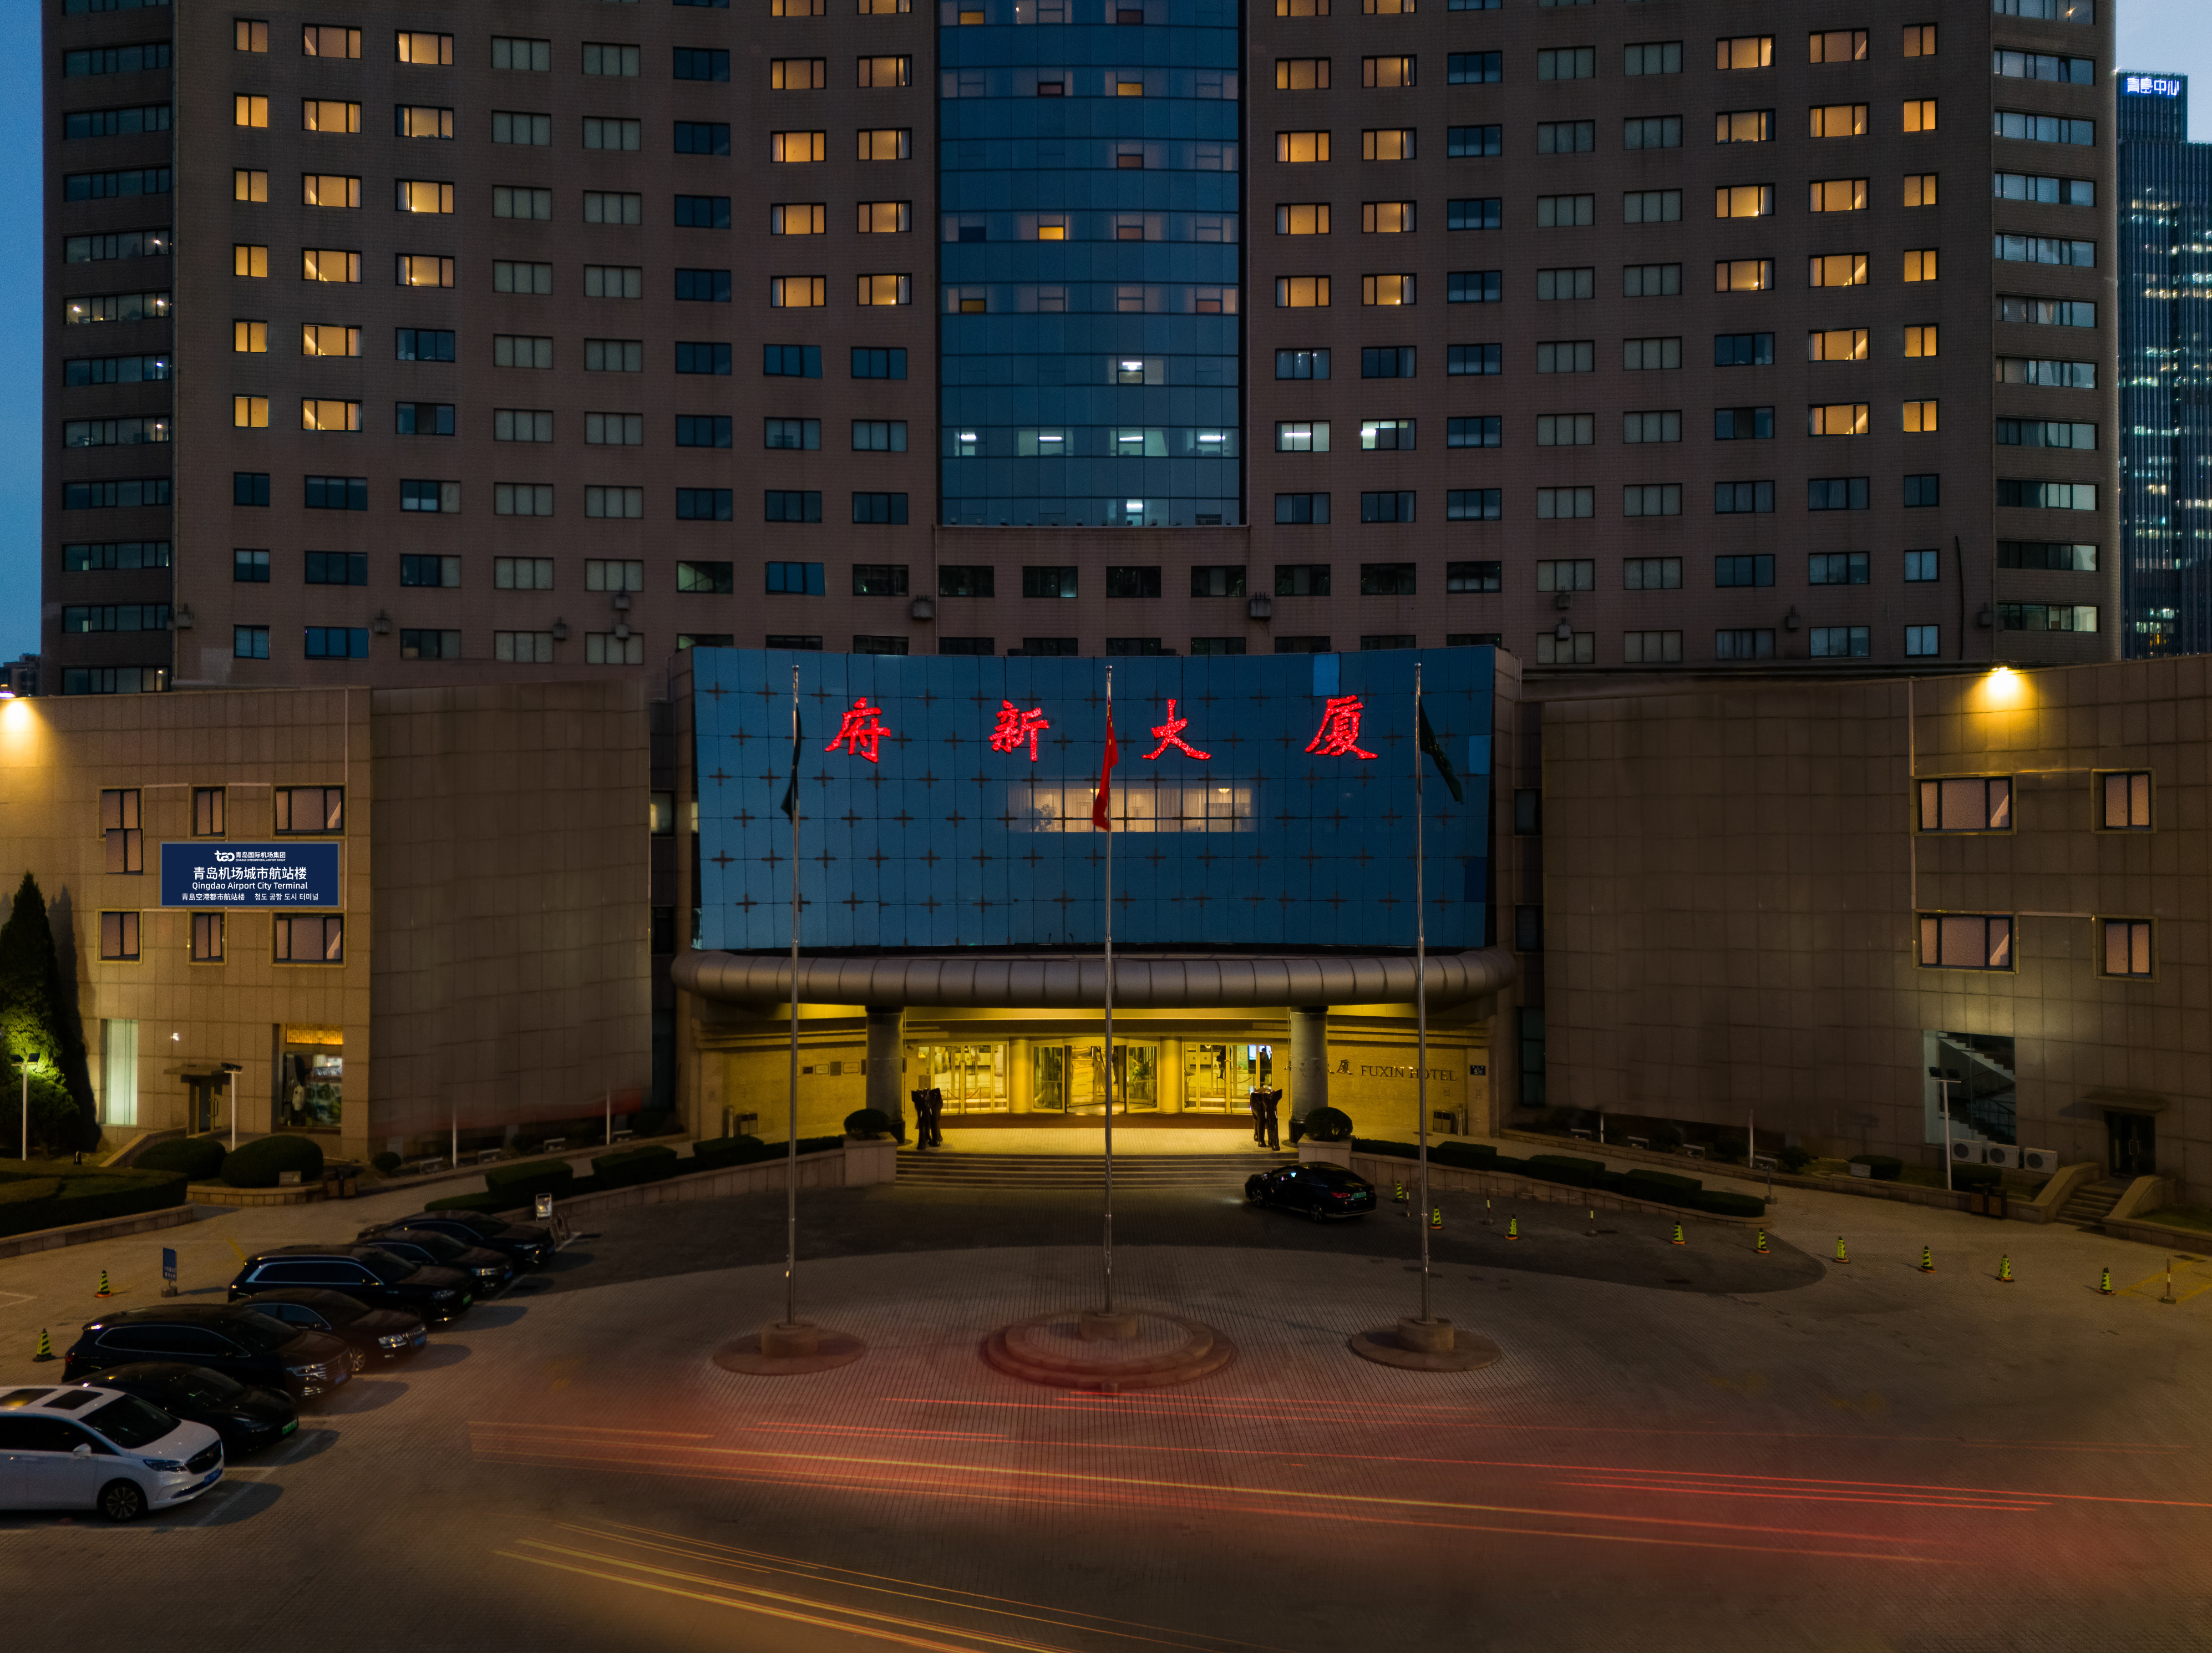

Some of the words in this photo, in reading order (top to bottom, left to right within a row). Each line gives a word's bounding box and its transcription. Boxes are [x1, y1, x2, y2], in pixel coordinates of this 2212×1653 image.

[193, 866, 307, 880] 青岛机场城市航站楼
[192, 881, 226, 891] Qingdao
[227, 881, 256, 891] Airport
[257, 881, 272, 891] City
[273, 881, 308, 890] Terminal
[181, 893, 245, 901] 青島空港都市航站楼
[254, 893, 267, 901] 청도
[269, 893, 282, 901] 공항
[284, 893, 297, 901] 도시
[299, 893, 318, 901] 터미널
[1360, 1065, 1405, 1078] FUXIN
